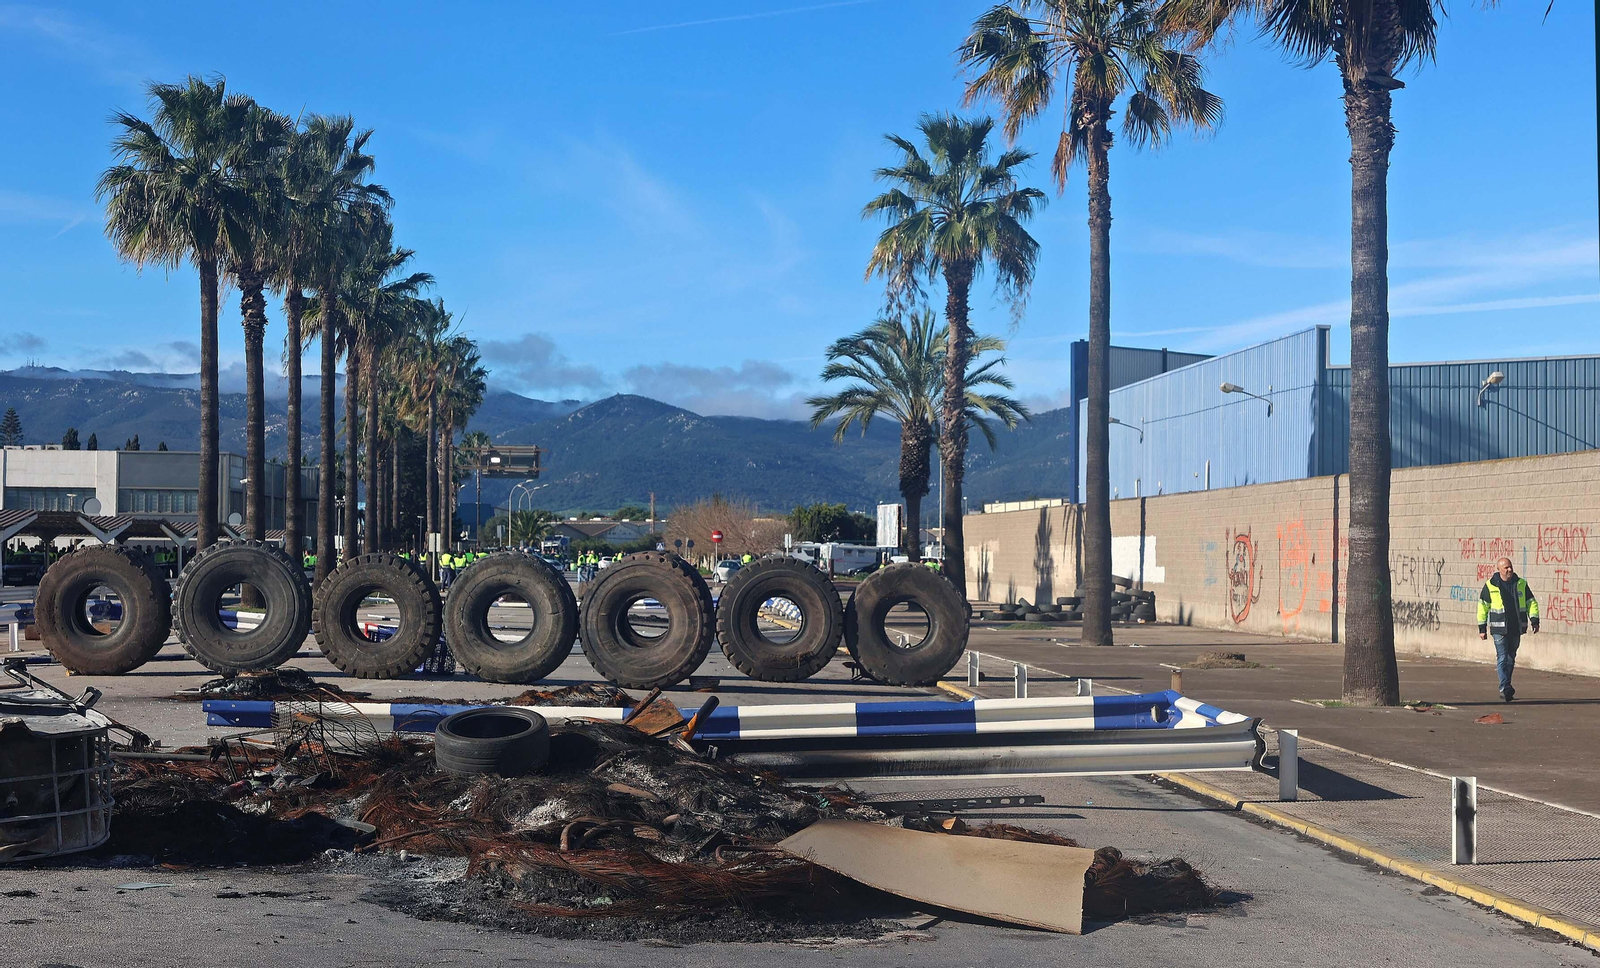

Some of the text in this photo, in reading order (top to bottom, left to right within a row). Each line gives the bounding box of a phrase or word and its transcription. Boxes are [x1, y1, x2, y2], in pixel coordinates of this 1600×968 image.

[1536, 523, 1589, 566] ASESINOX
[1554, 569, 1570, 594] TE
[1546, 591, 1594, 626] ASESINA
